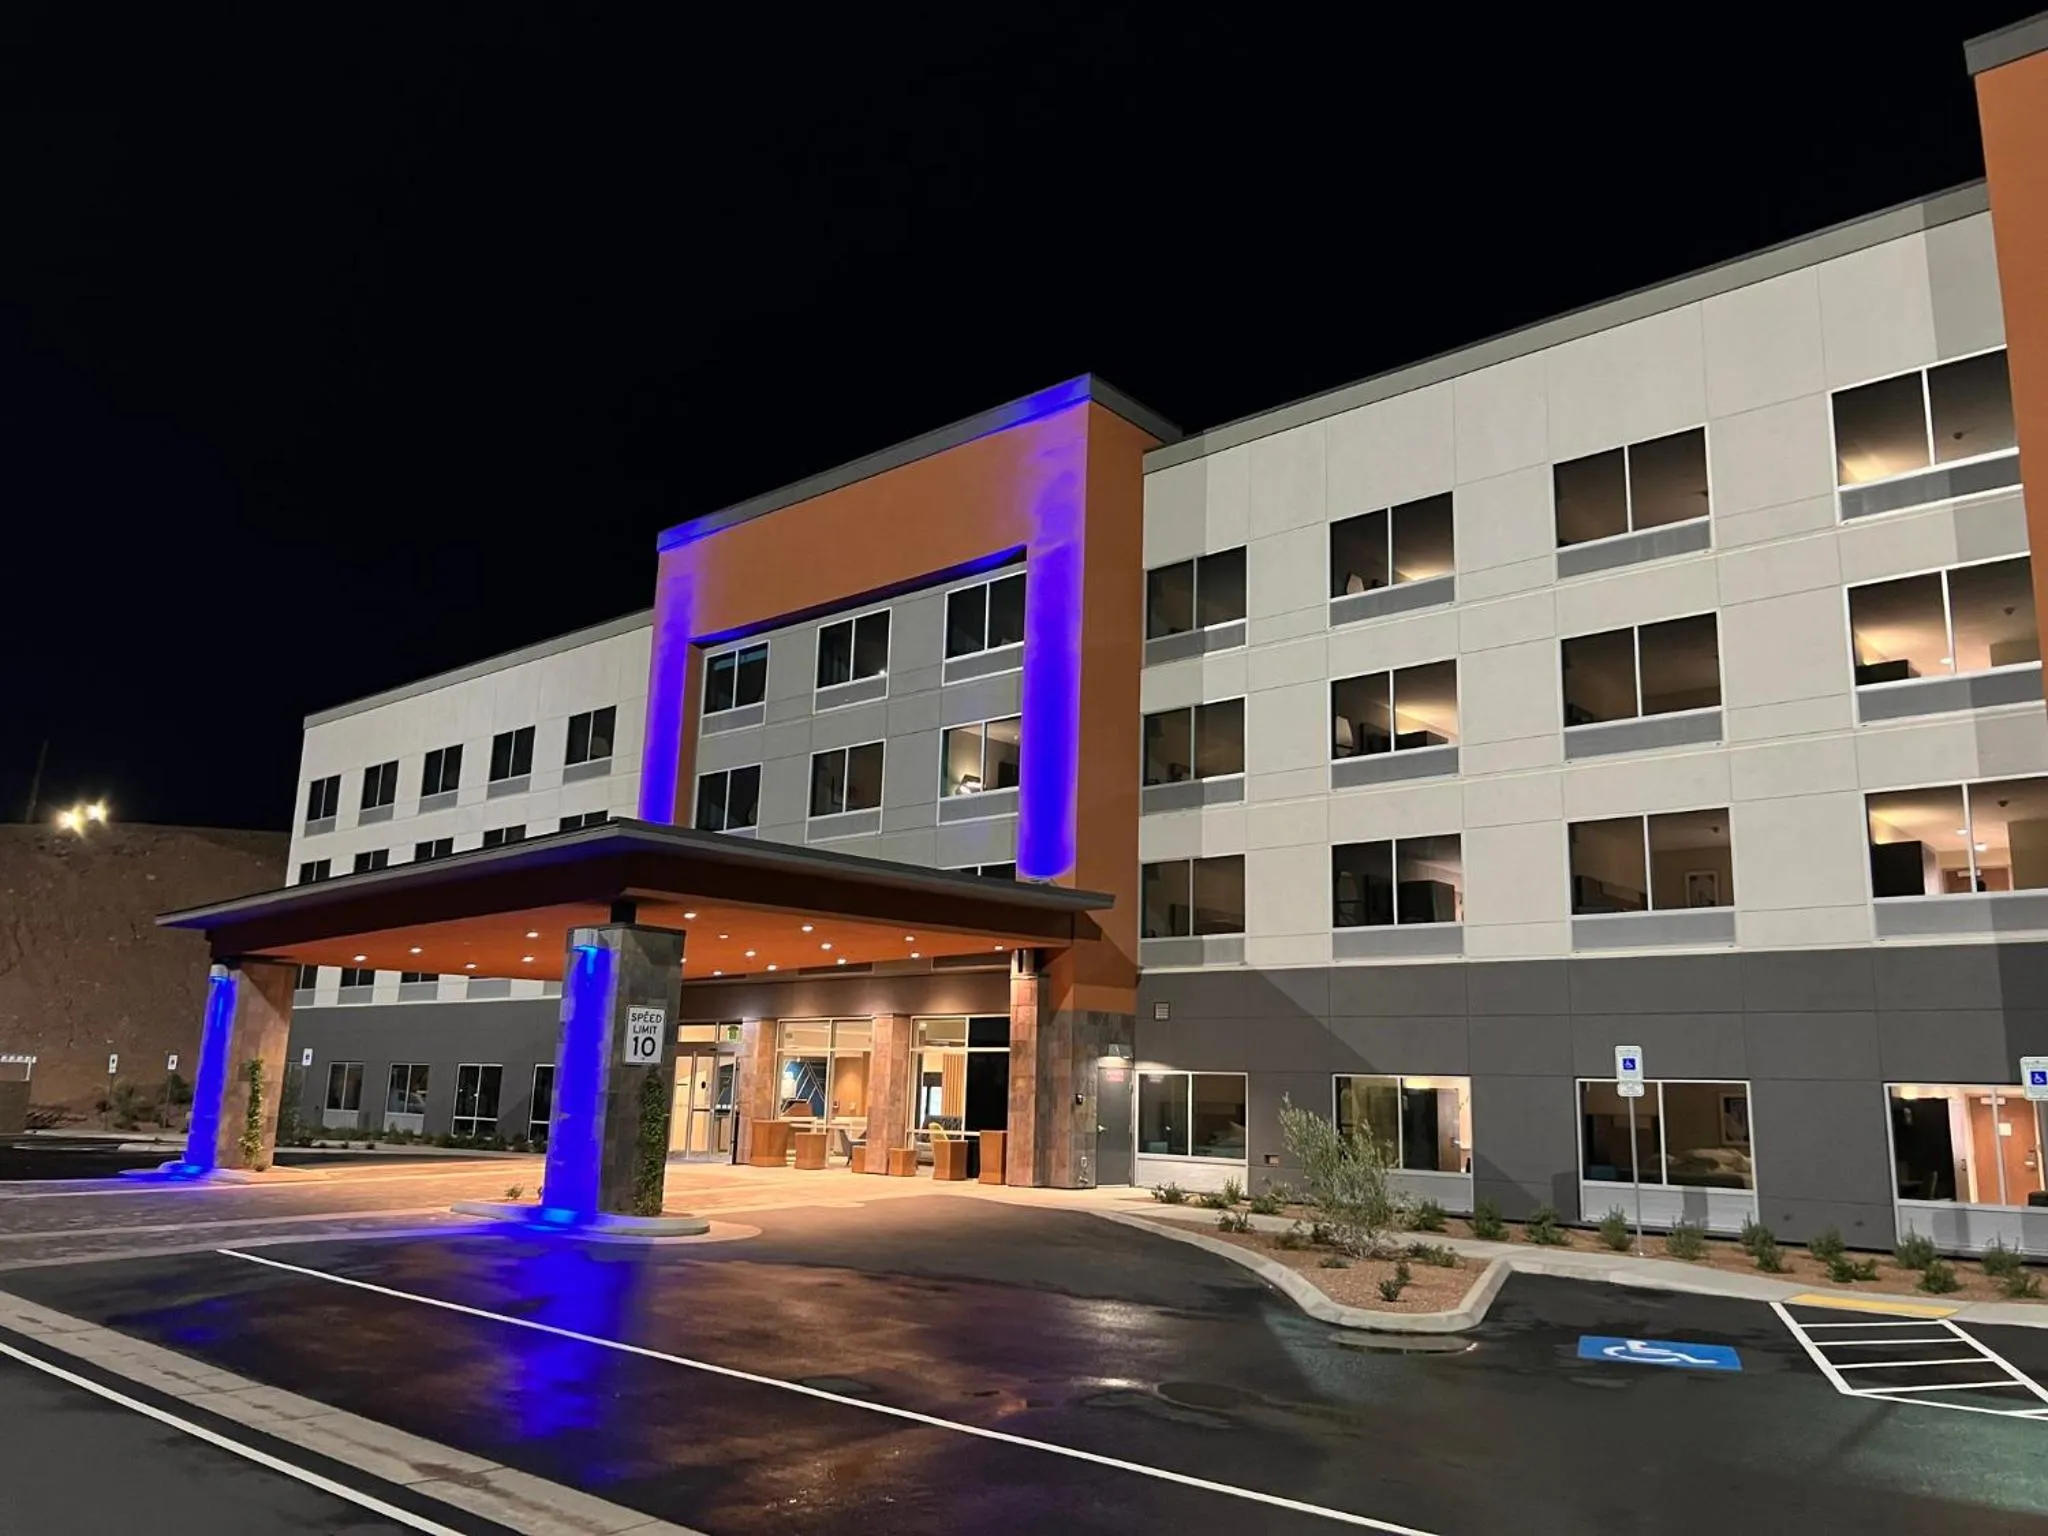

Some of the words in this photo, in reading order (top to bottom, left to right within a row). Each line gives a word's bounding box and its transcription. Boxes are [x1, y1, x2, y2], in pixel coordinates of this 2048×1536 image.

[631, 1012, 663, 1023] SPEED
[633, 1025, 657, 1035] LIMIT
[633, 1036, 656, 1057] 10
